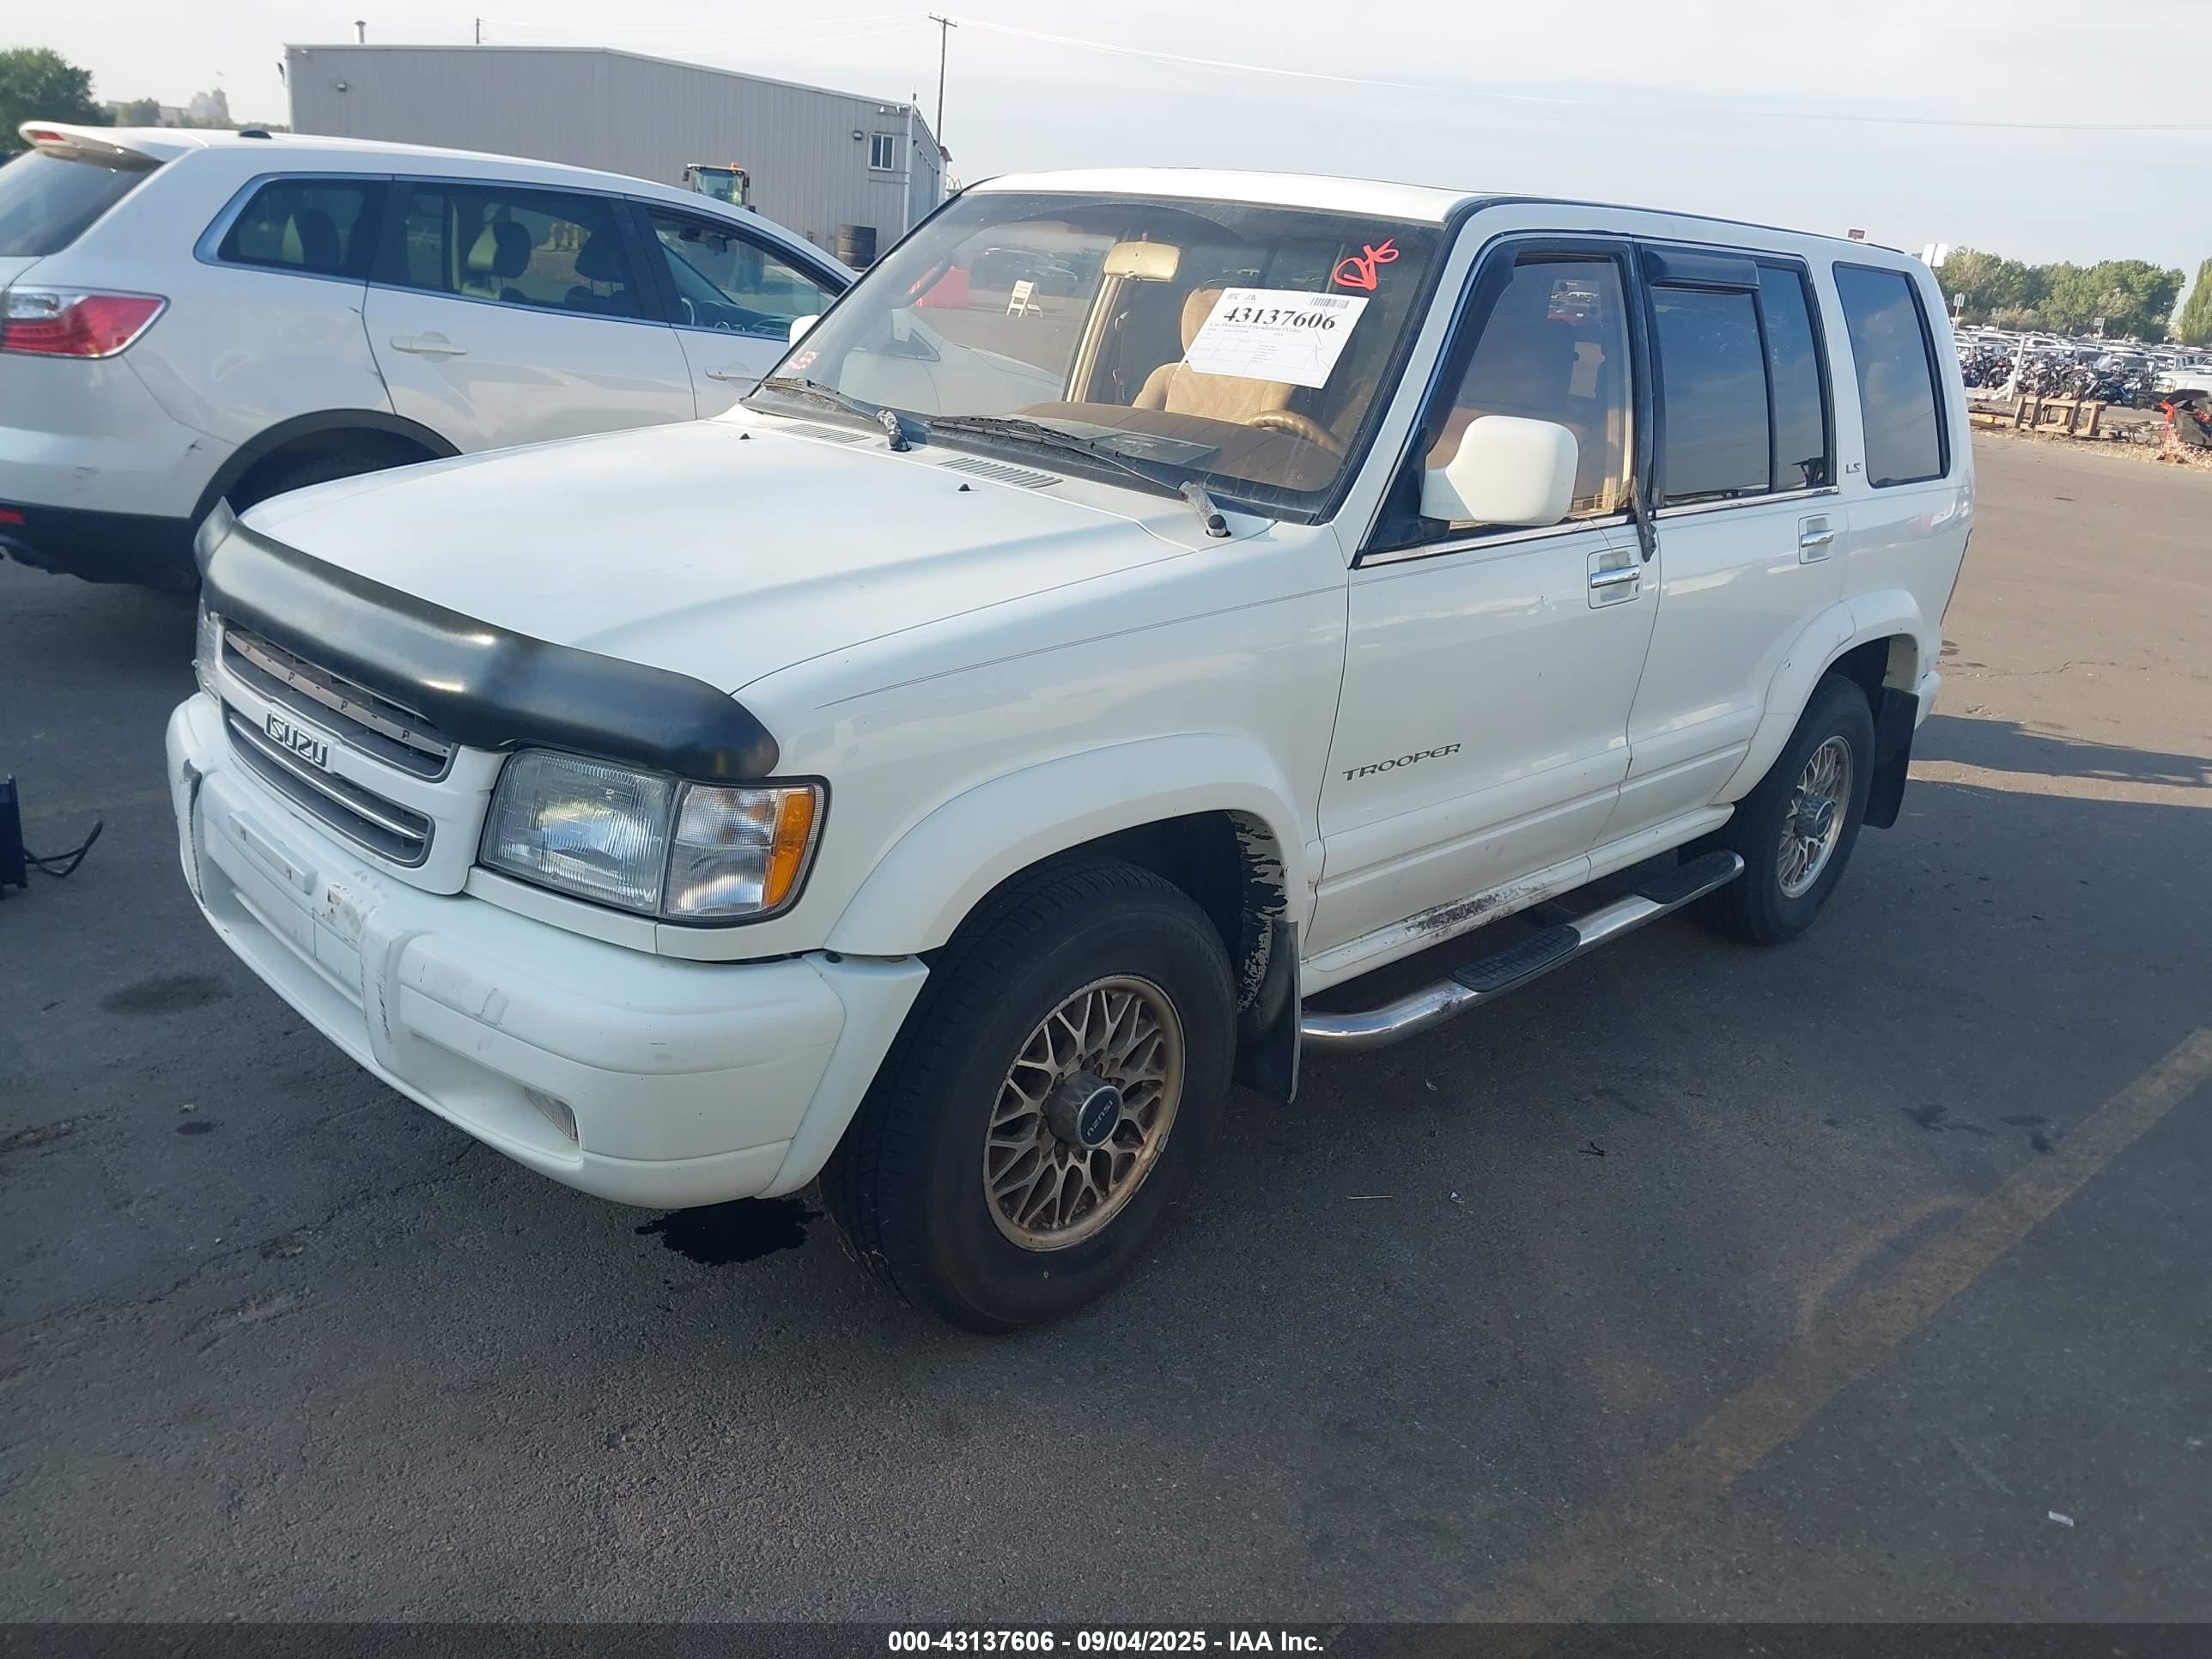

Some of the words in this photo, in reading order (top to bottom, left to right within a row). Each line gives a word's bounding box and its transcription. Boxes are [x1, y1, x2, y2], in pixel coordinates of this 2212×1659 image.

[1223, 307, 1340, 331] 43137606
[1845, 463, 1862, 474] LS
[265, 711, 328, 769] ISUZU
[1342, 743, 1462, 781] TROOPER
[1086, 1099, 1114, 1138] ISUZU
